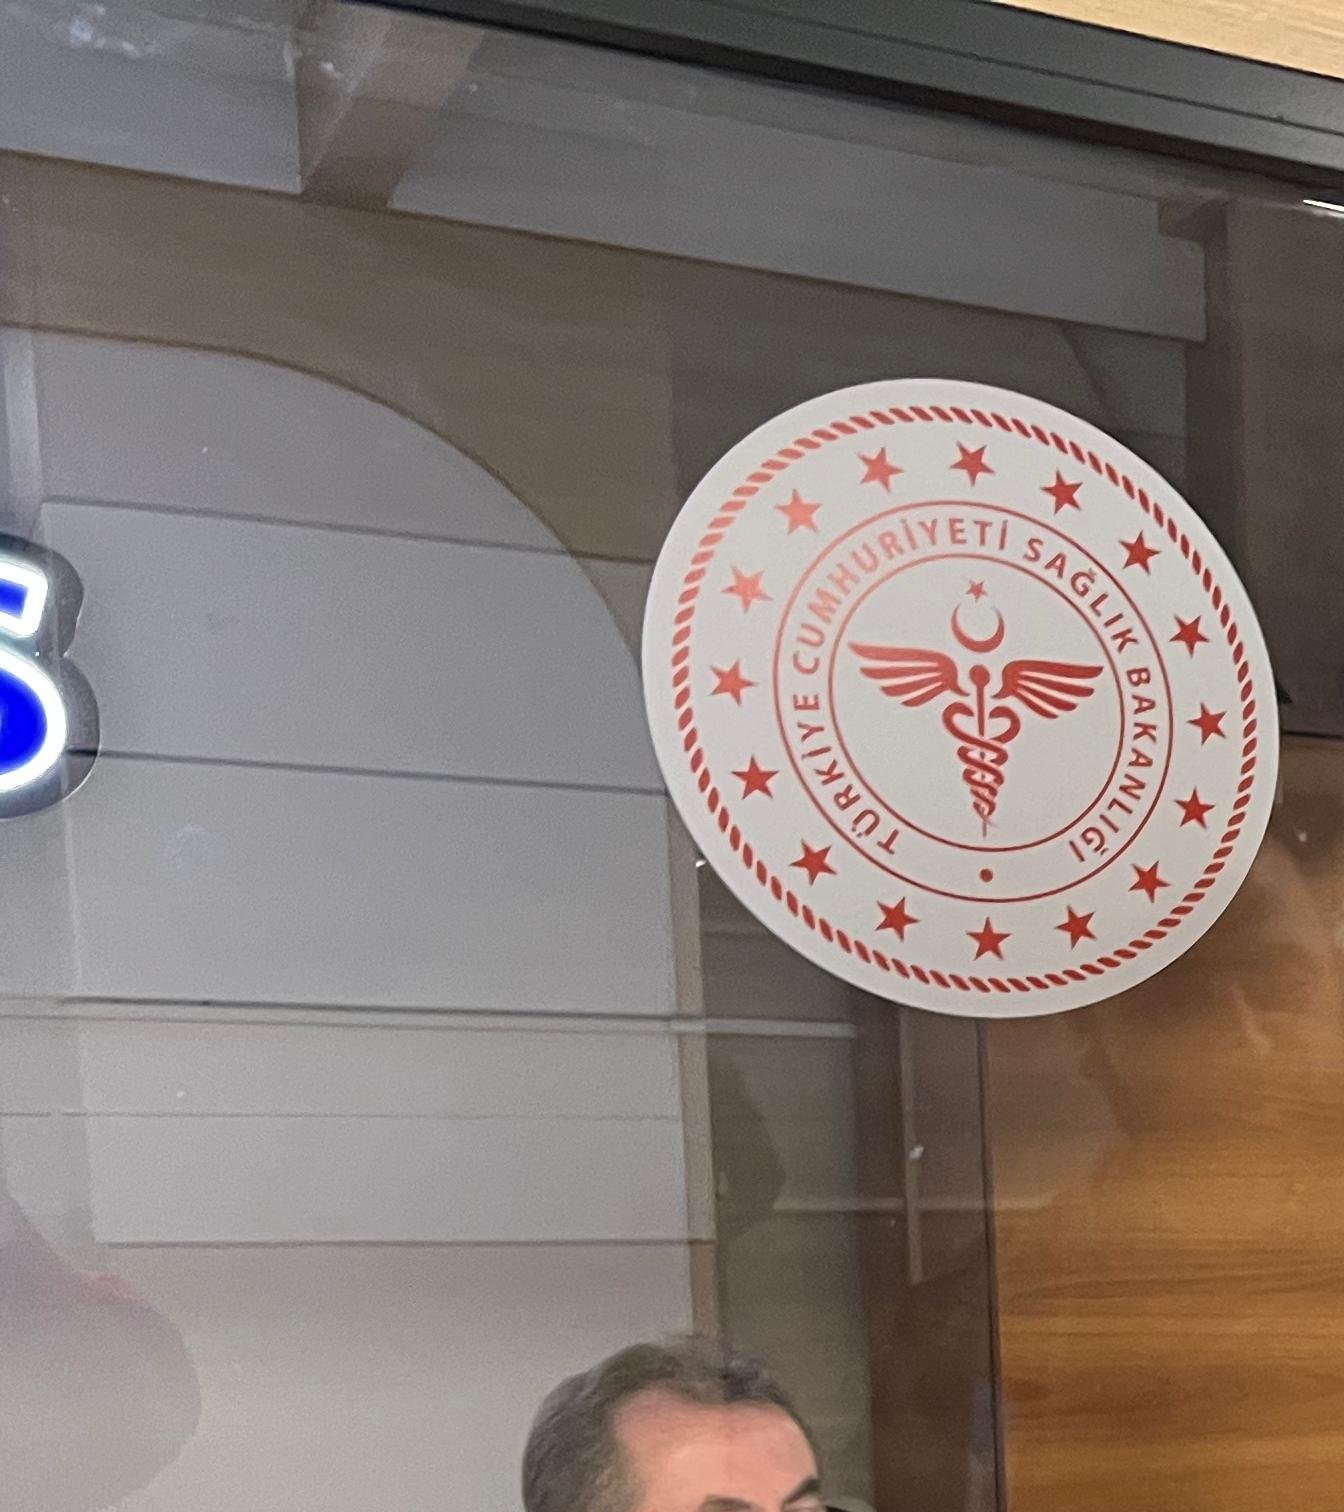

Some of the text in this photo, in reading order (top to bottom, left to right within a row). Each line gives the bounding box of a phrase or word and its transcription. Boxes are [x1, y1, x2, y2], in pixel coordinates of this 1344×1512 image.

[793, 517, 1158, 863] TÜRKİYE CUMHURİYETİ SAĞLIK BAKANLIĞI
